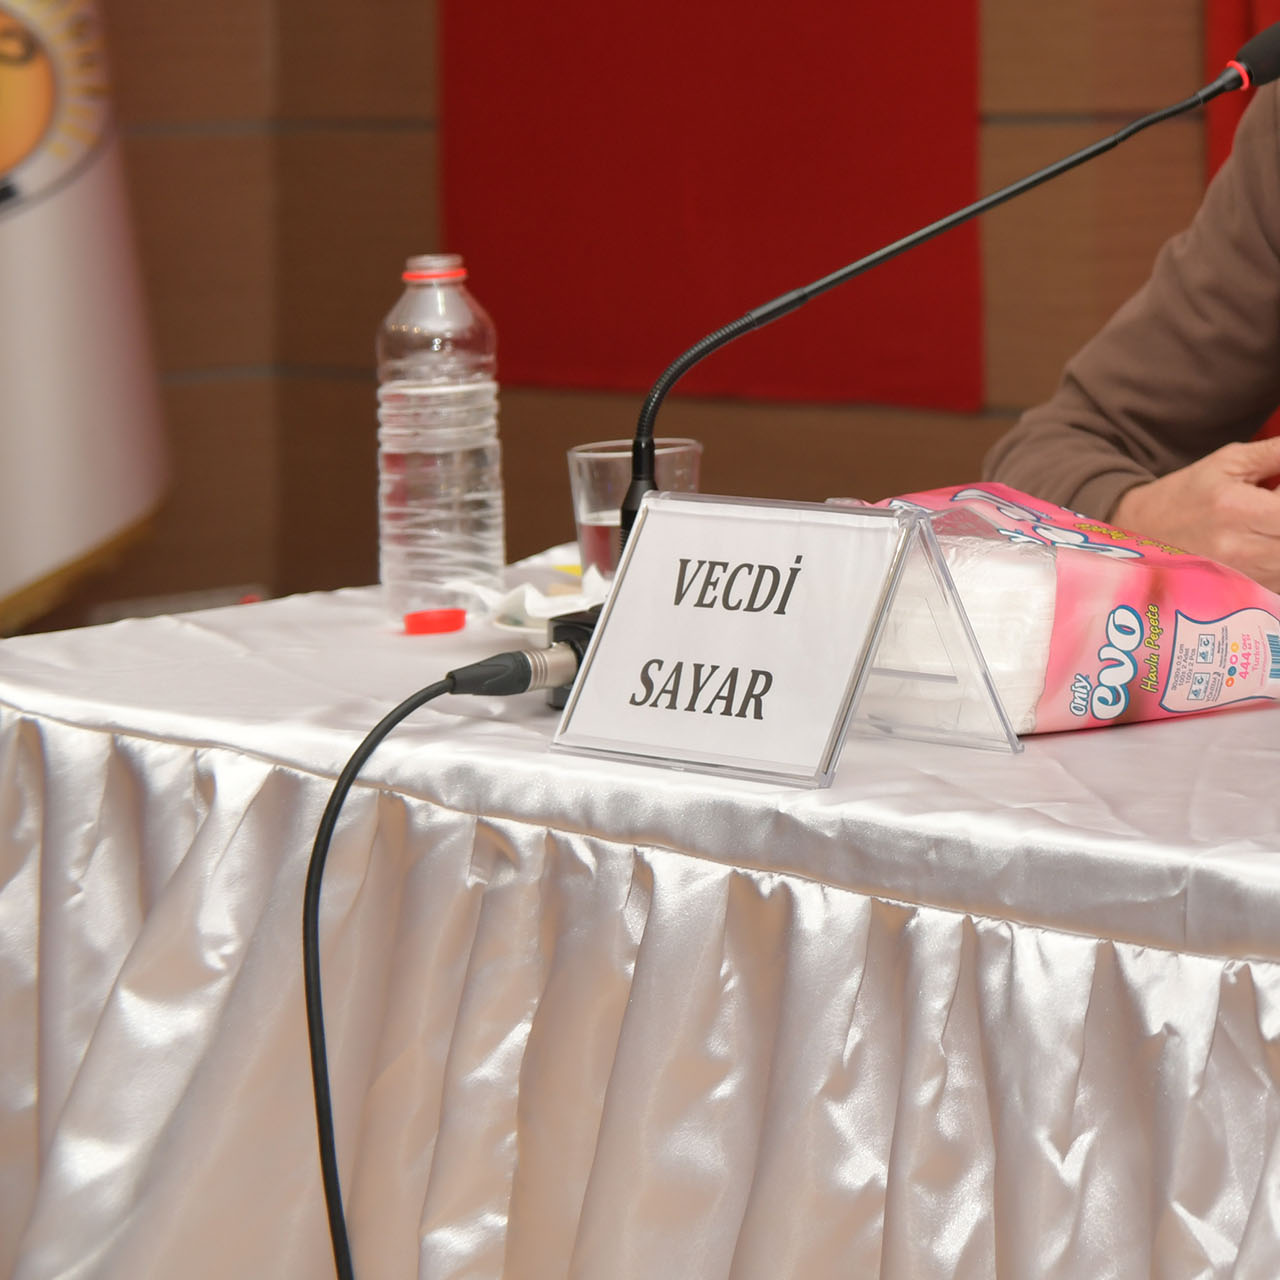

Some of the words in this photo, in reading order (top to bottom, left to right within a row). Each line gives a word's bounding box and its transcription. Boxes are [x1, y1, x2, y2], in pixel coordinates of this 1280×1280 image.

[673, 554, 803, 615] VECDİ
[1144, 604, 1163, 650] Peçete
[1090, 604, 1144, 720] evo
[1141, 653, 1160, 693] Havlu
[1239, 652, 1251, 680] 444
[629, 658, 773, 721] SAYAR
